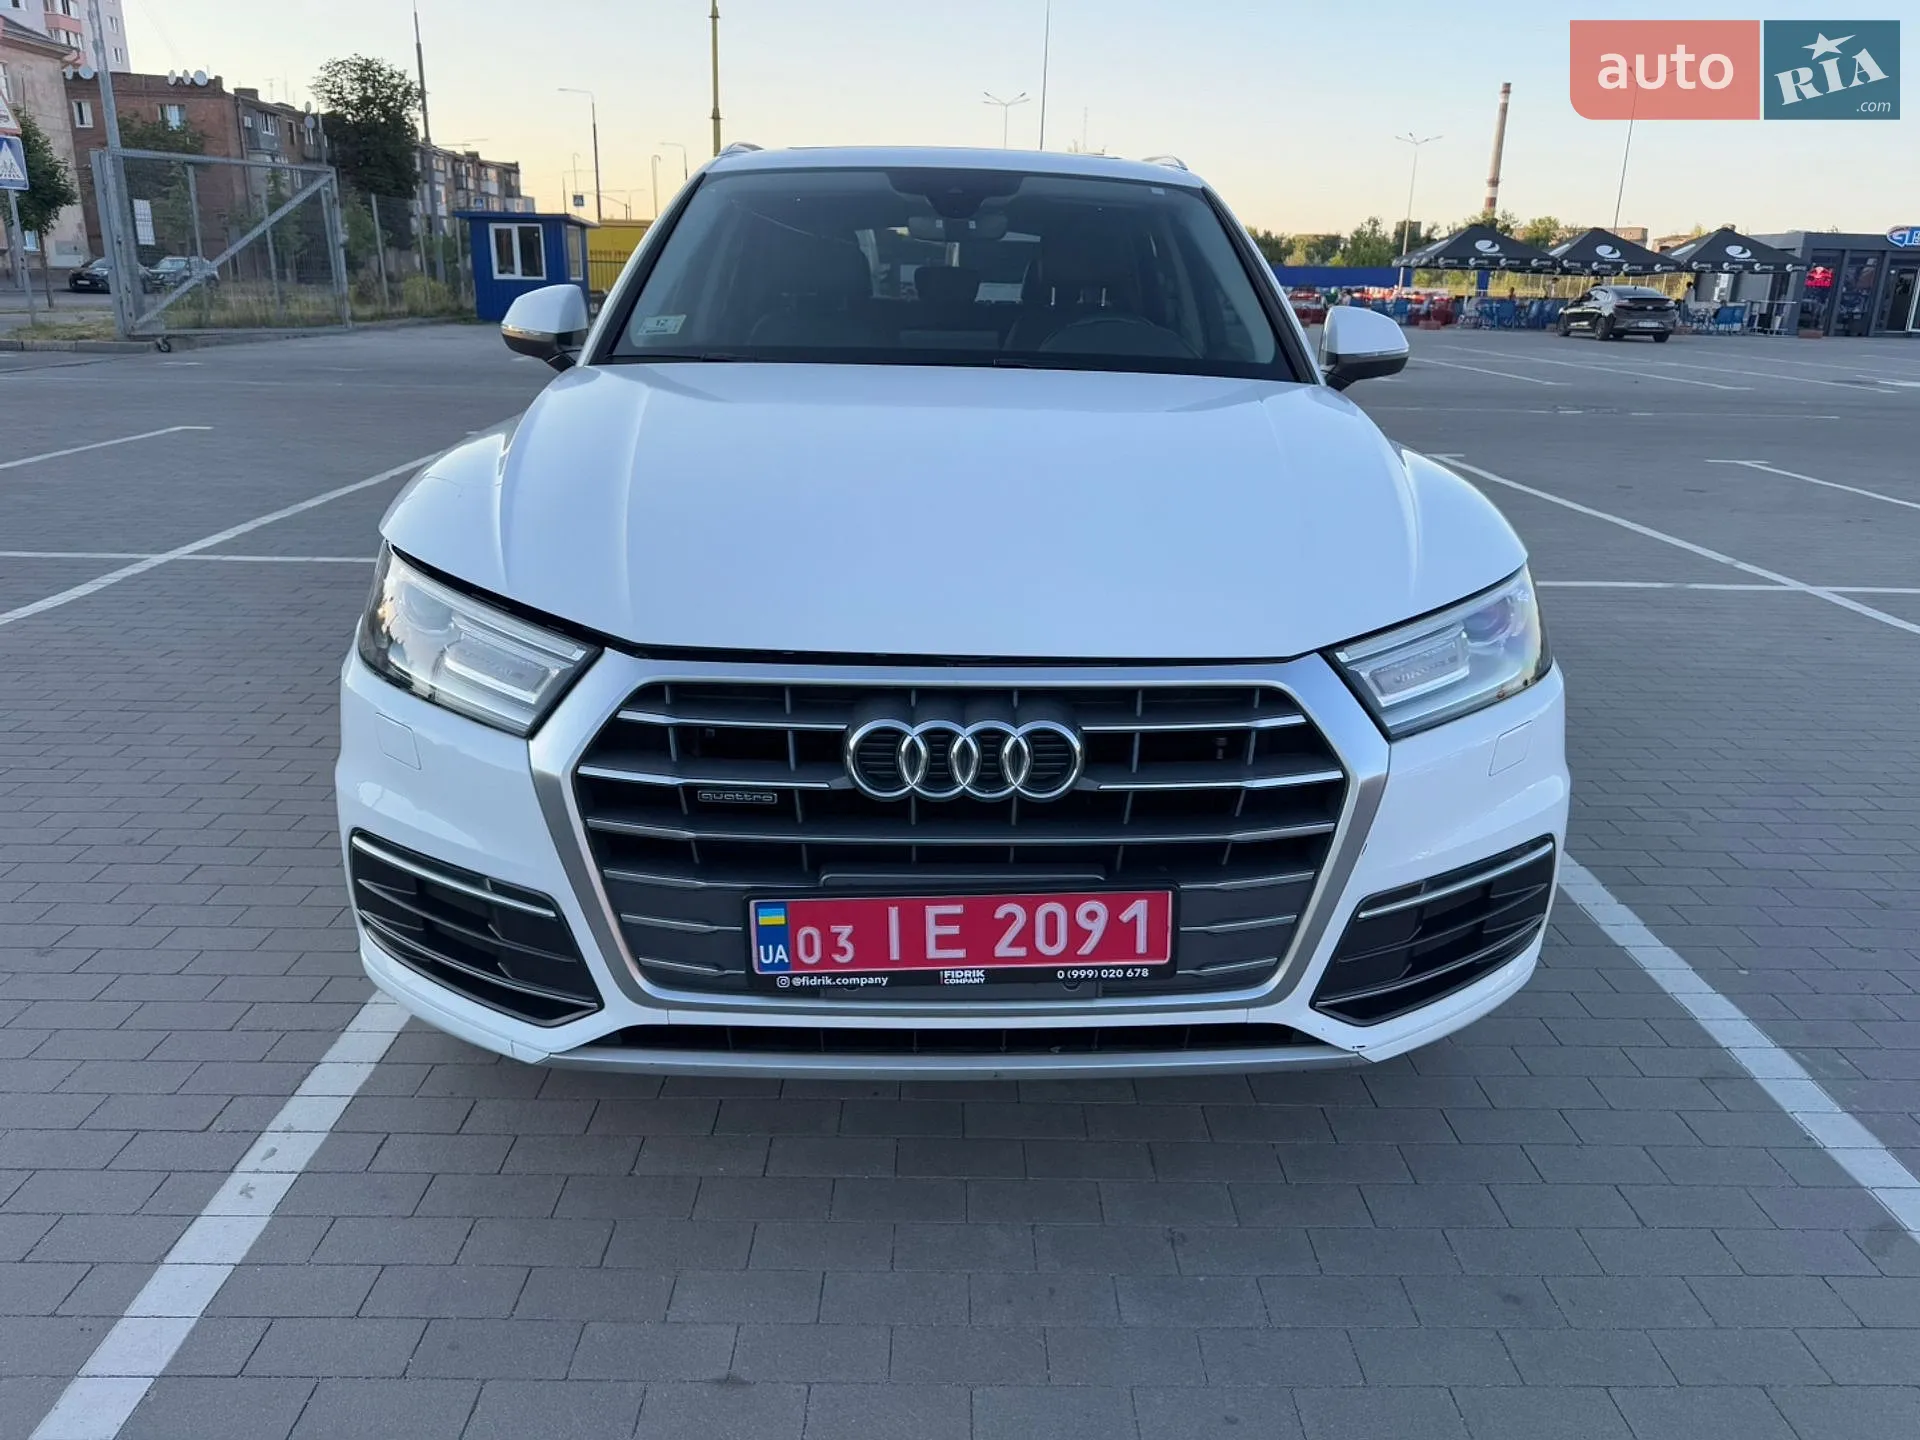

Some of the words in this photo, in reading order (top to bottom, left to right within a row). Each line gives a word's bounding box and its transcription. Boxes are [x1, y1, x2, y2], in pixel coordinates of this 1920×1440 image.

[701, 792, 773, 801] quattro
[797, 926, 855, 964] 03
[993, 900, 1149, 957] 2091
[759, 944, 788, 964] UA
[944, 969, 985, 979] FIDRIK
[1057, 970, 1066, 980] 0
[1067, 969, 1098, 980] (999)
[1100, 969, 1124, 979] 020
[1126, 967, 1149, 978] 678
[791, 975, 888, 987] @fidrik.company
[944, 977, 985, 985] COMPANY
